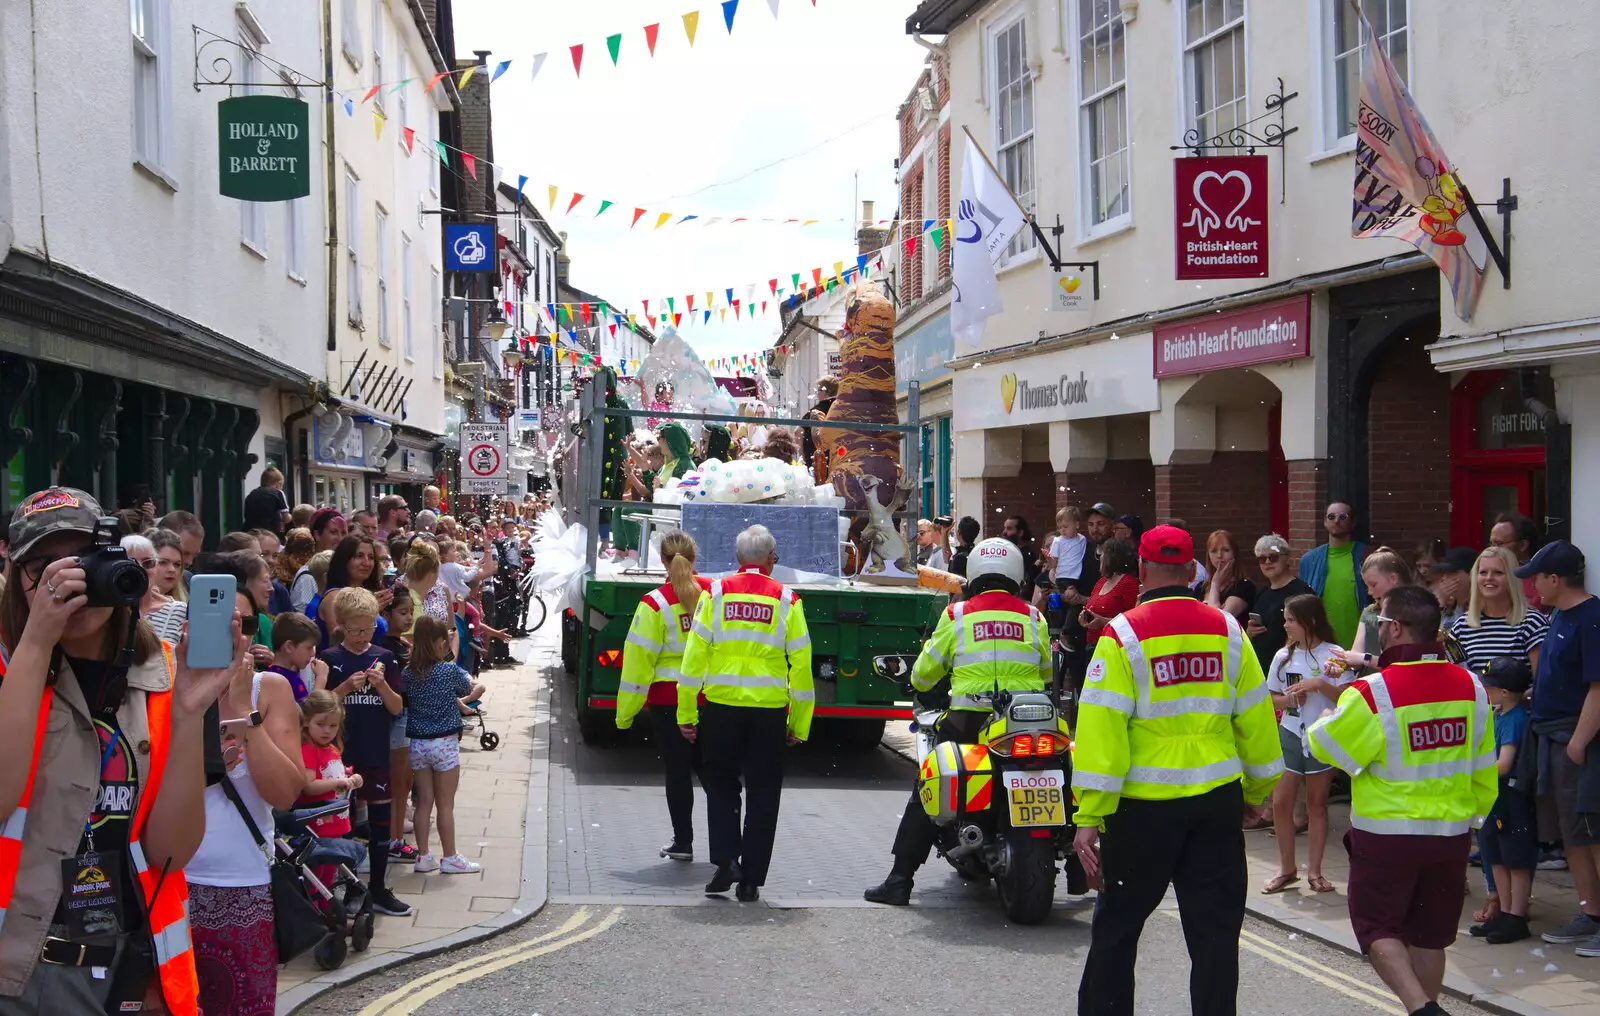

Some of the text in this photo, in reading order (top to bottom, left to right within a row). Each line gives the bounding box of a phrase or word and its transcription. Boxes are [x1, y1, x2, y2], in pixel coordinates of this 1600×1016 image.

[229, 122, 299, 140] HOLLAND
[1363, 111, 1395, 142] SOON
[256, 138, 271, 156] &
[229, 156, 298, 174] BARRETT
[1186, 240, 1258, 252] British Heart
[1186, 252, 1259, 265] Foundation
[1163, 316, 1297, 362] British Heart Foundation
[1018, 371, 1088, 410] Thomas Cook
[1492, 413, 1518, 435] FIGHT
[1520, 412, 1538, 432] FOR
[468, 432, 500, 442] ZONE
[980, 547, 1008, 557] BLOOD
[725, 604, 771, 620] BLOOD
[974, 623, 1023, 639] BLOOD
[1154, 656, 1219, 683] BLOOD
[343, 693, 383, 705] mirates
[1411, 721, 1466, 747] BLOOD
[1010, 776, 1057, 788] BLOOD
[1011, 788, 1060, 805] LD58
[1018, 805, 1056, 822] DPY
